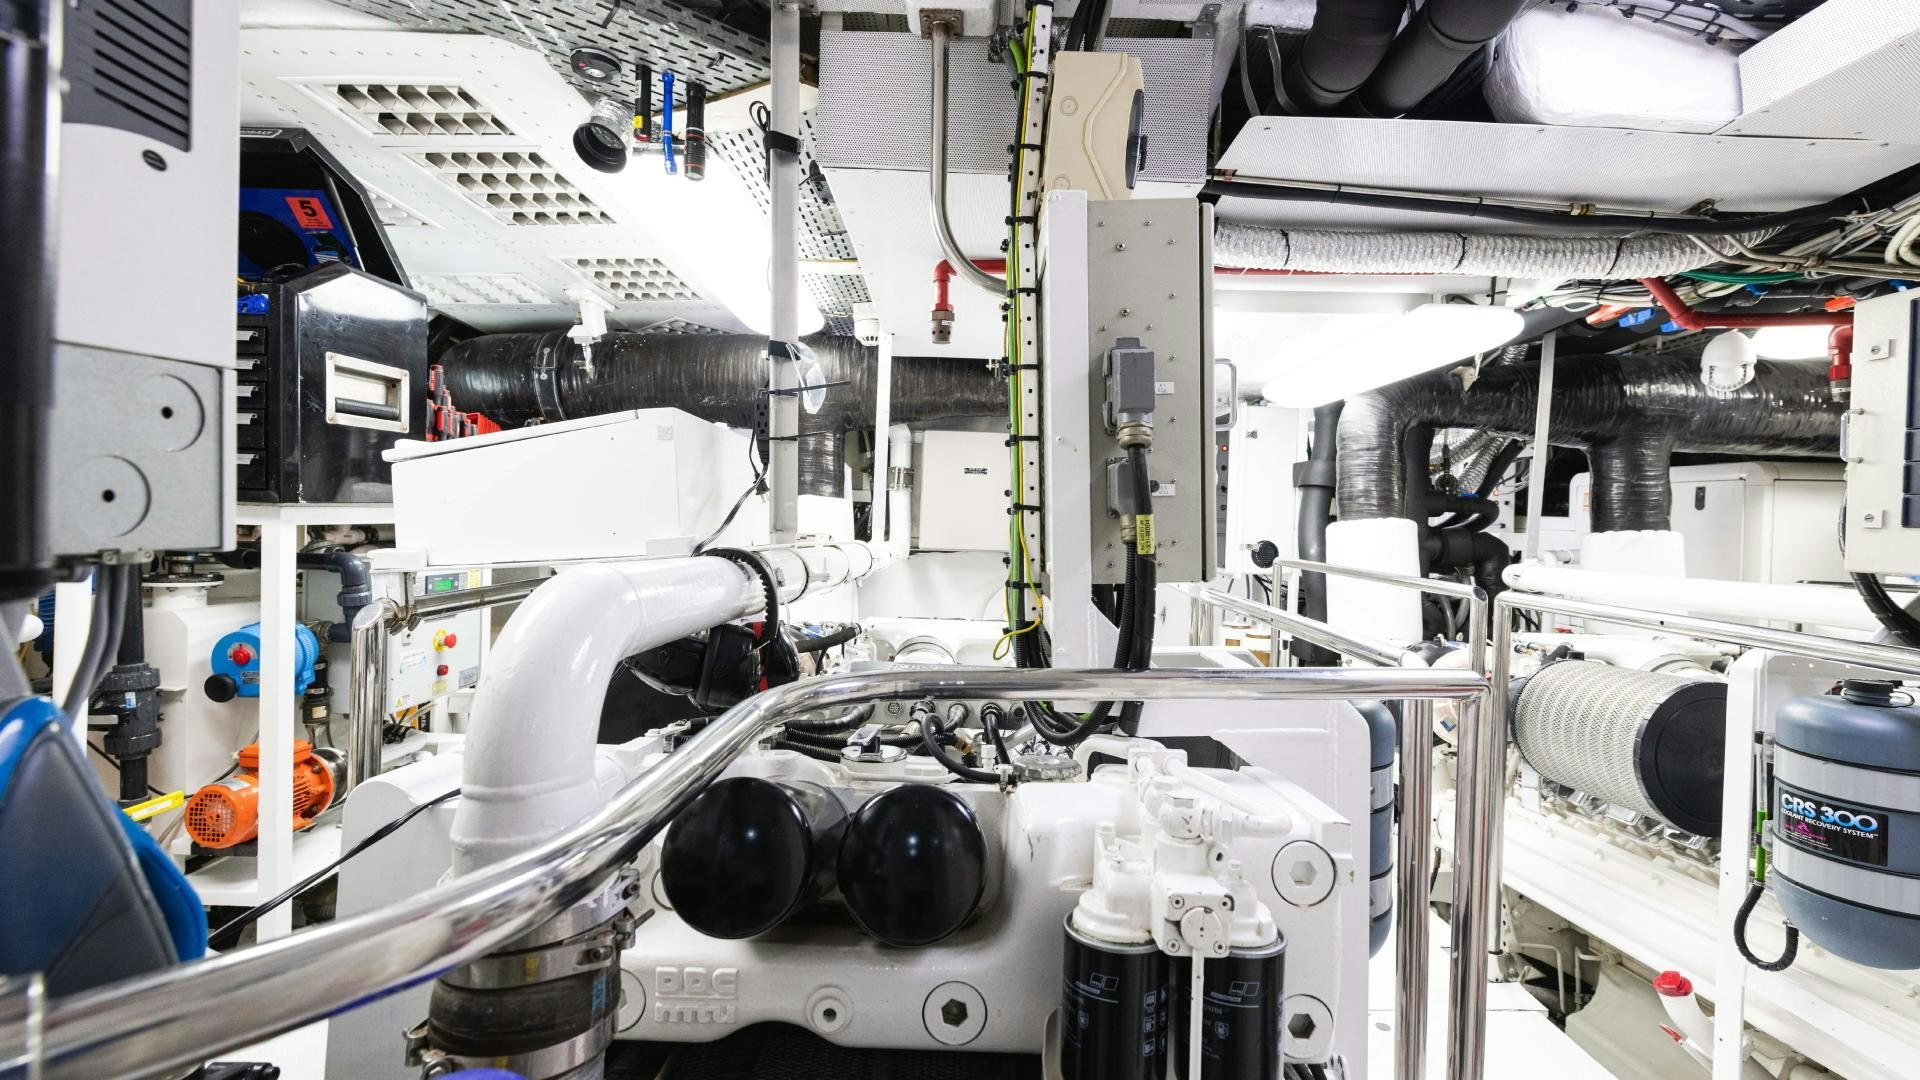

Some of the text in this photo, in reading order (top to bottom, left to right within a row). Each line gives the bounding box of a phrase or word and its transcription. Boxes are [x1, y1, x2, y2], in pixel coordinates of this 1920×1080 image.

[299, 200, 317, 217] 5
[1781, 793, 1816, 819] CRS
[1820, 806, 1878, 832] 300
[1805, 817, 1841, 832] RECOVERY
